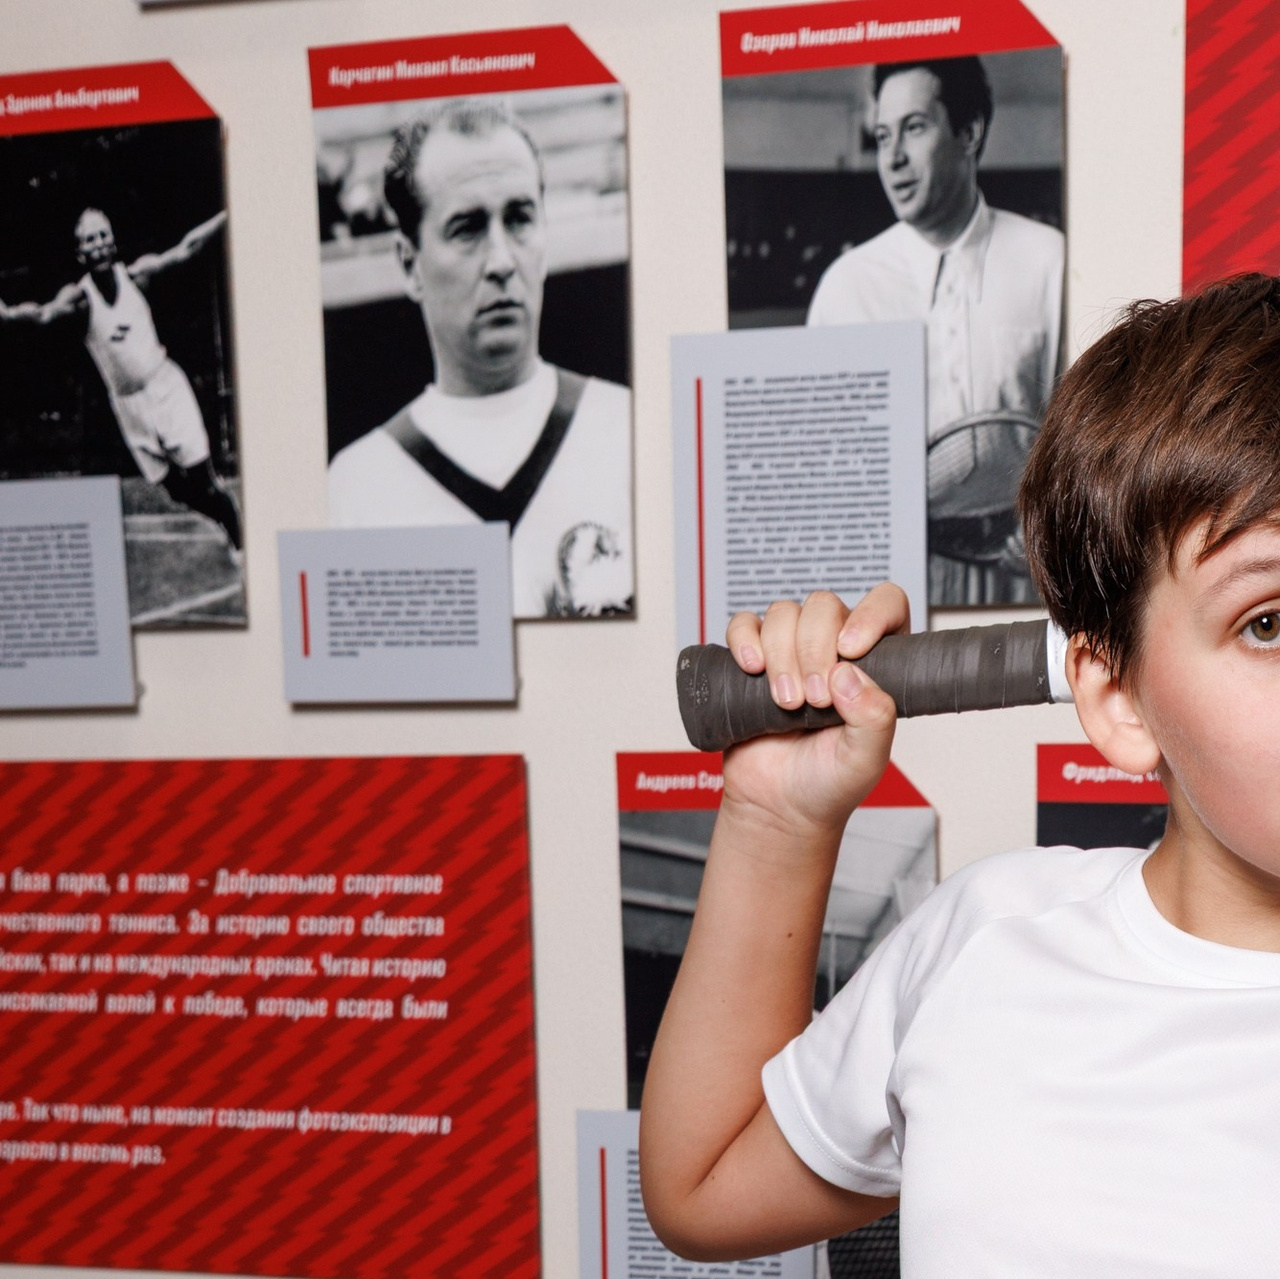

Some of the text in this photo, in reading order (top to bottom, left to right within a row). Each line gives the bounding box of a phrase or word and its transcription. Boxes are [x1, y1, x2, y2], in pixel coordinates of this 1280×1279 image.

[798, 22, 864, 47] Николай
[866, 16, 961, 40] Николаевич
[635, 772, 696, 793] Андреев
[11, 866, 50, 893] база
[214, 868, 336, 899] Добровольное
[343, 873, 443, 899] спортивное
[187, 909, 209, 934] За
[215, 914, 290, 939] историю
[296, 915, 355, 936] своего
[361, 910, 444, 937] общества
[371, 958, 446, 982] историю
[105, 990, 155, 1014] волей
[256, 998, 328, 1022] которые
[336, 998, 393, 1021] всегда
[402, 994, 448, 1019] были
[153, 1107, 215, 1126] момент
[216, 1108, 295, 1130] создания
[297, 1106, 438, 1135] фотоэкспозиции
[440, 1115, 452, 1135] в
